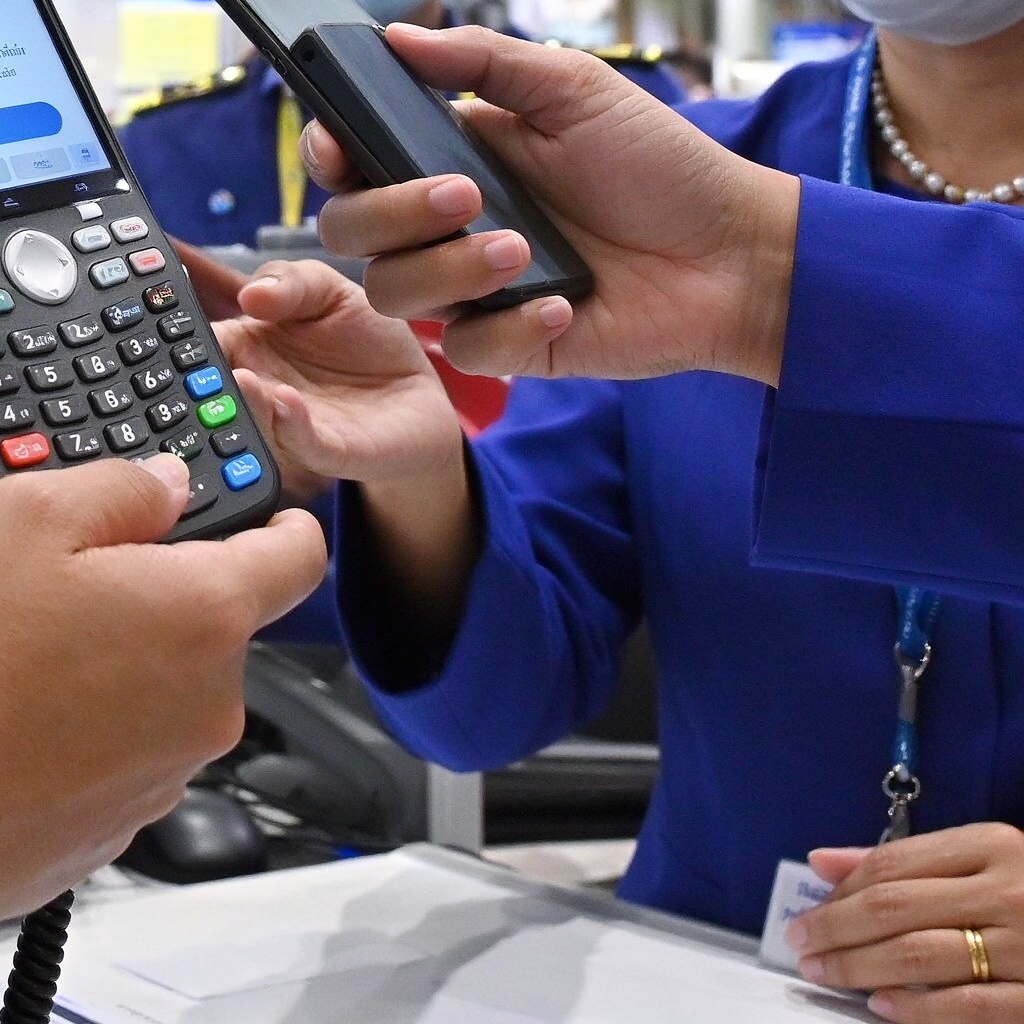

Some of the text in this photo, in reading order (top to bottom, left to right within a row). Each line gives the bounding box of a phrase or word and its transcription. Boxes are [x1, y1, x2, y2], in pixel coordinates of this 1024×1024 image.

[130, 339, 143, 355] 3
[44, 366, 58, 383] 5
[145, 371, 157, 389] 6
[4, 404, 16, 422] 4
[58, 400, 72, 417] 5
[121, 423, 136, 442] 8
